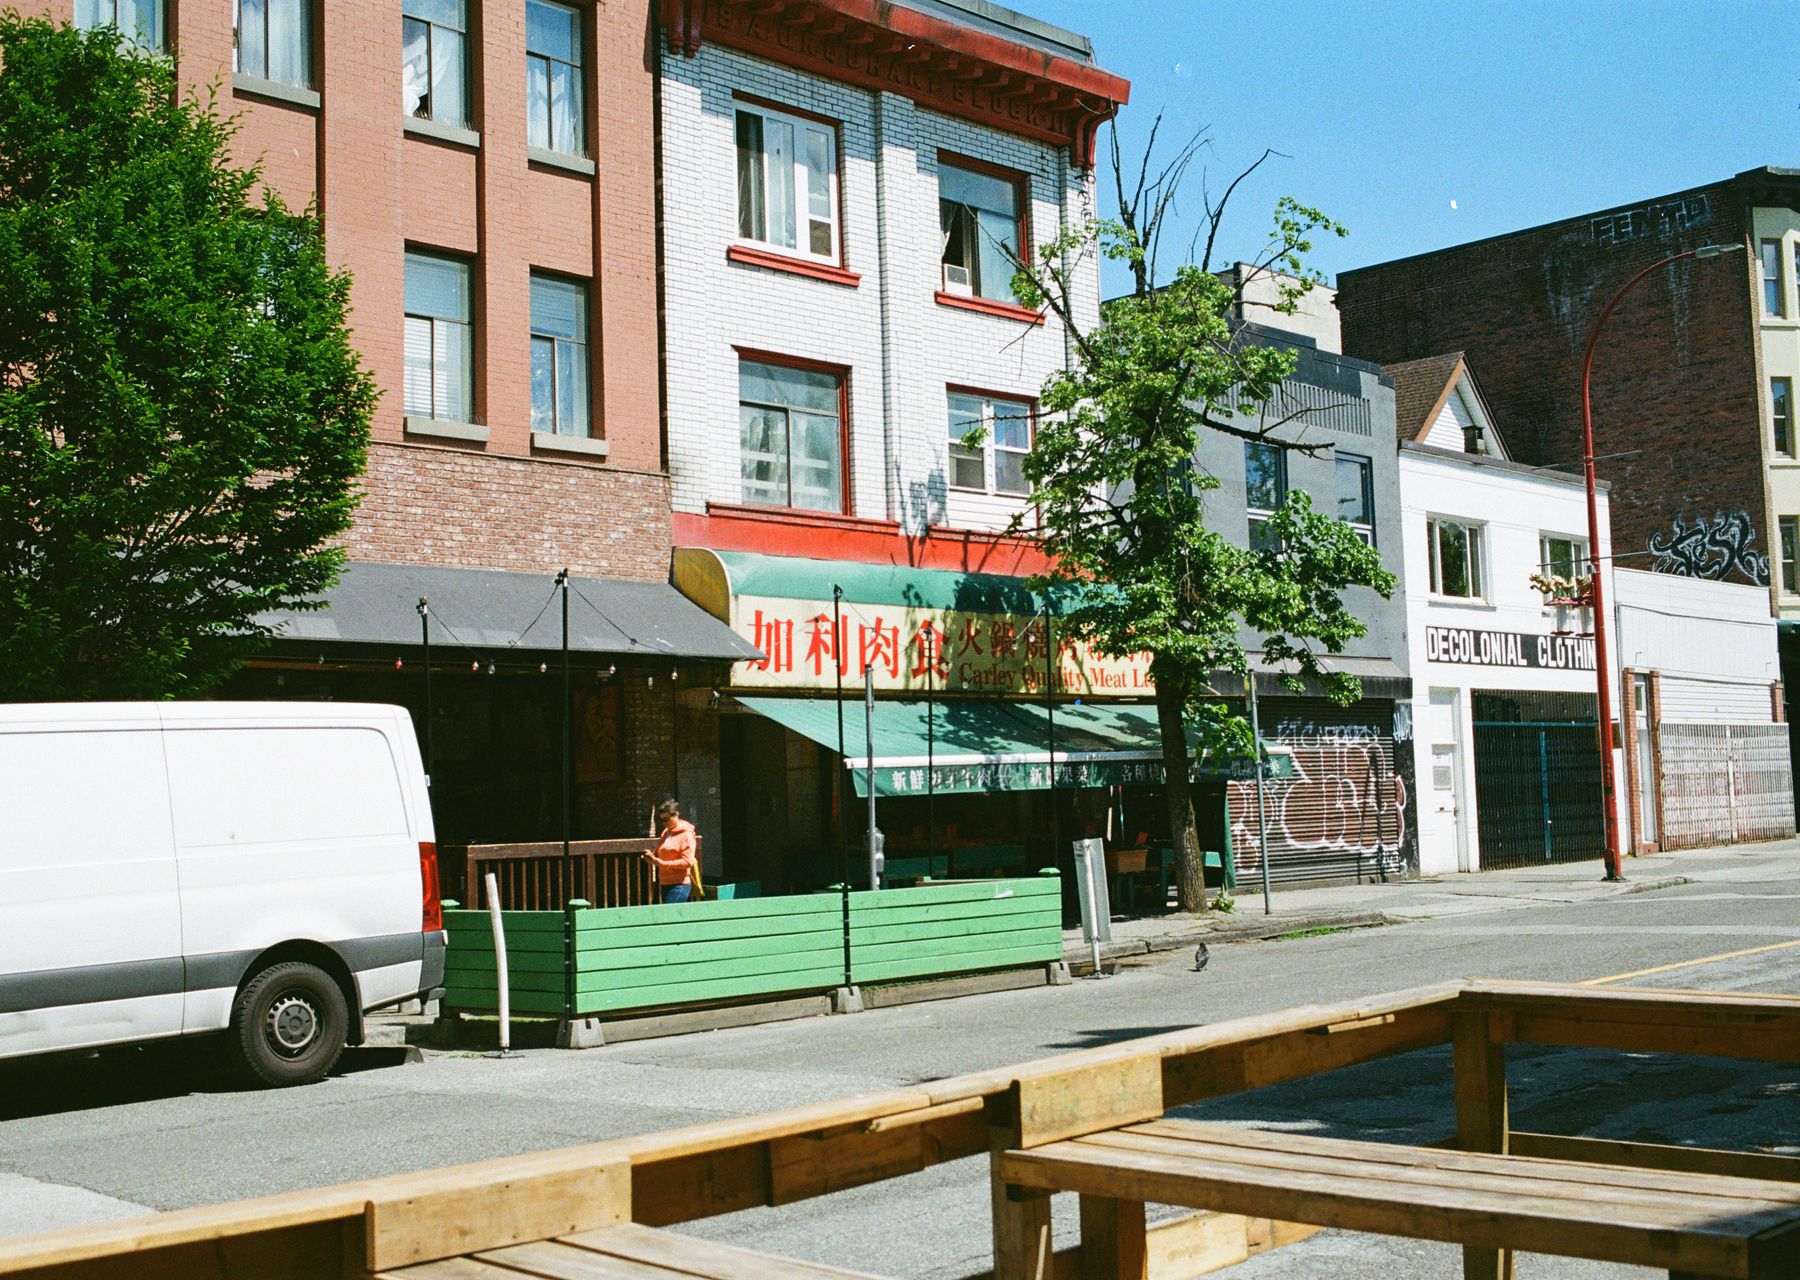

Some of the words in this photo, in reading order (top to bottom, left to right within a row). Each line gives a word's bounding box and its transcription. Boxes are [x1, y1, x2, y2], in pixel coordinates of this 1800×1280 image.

[745, 608, 951, 681] 加利肉食
[1426, 626, 1528, 667] DECOLONIAL
[1537, 635, 1597, 671] CLOTHIN
[959, 662, 1016, 689] Carley
[1022, 664, 1086, 692] Quality
[1090, 667, 1128, 689] Meat
